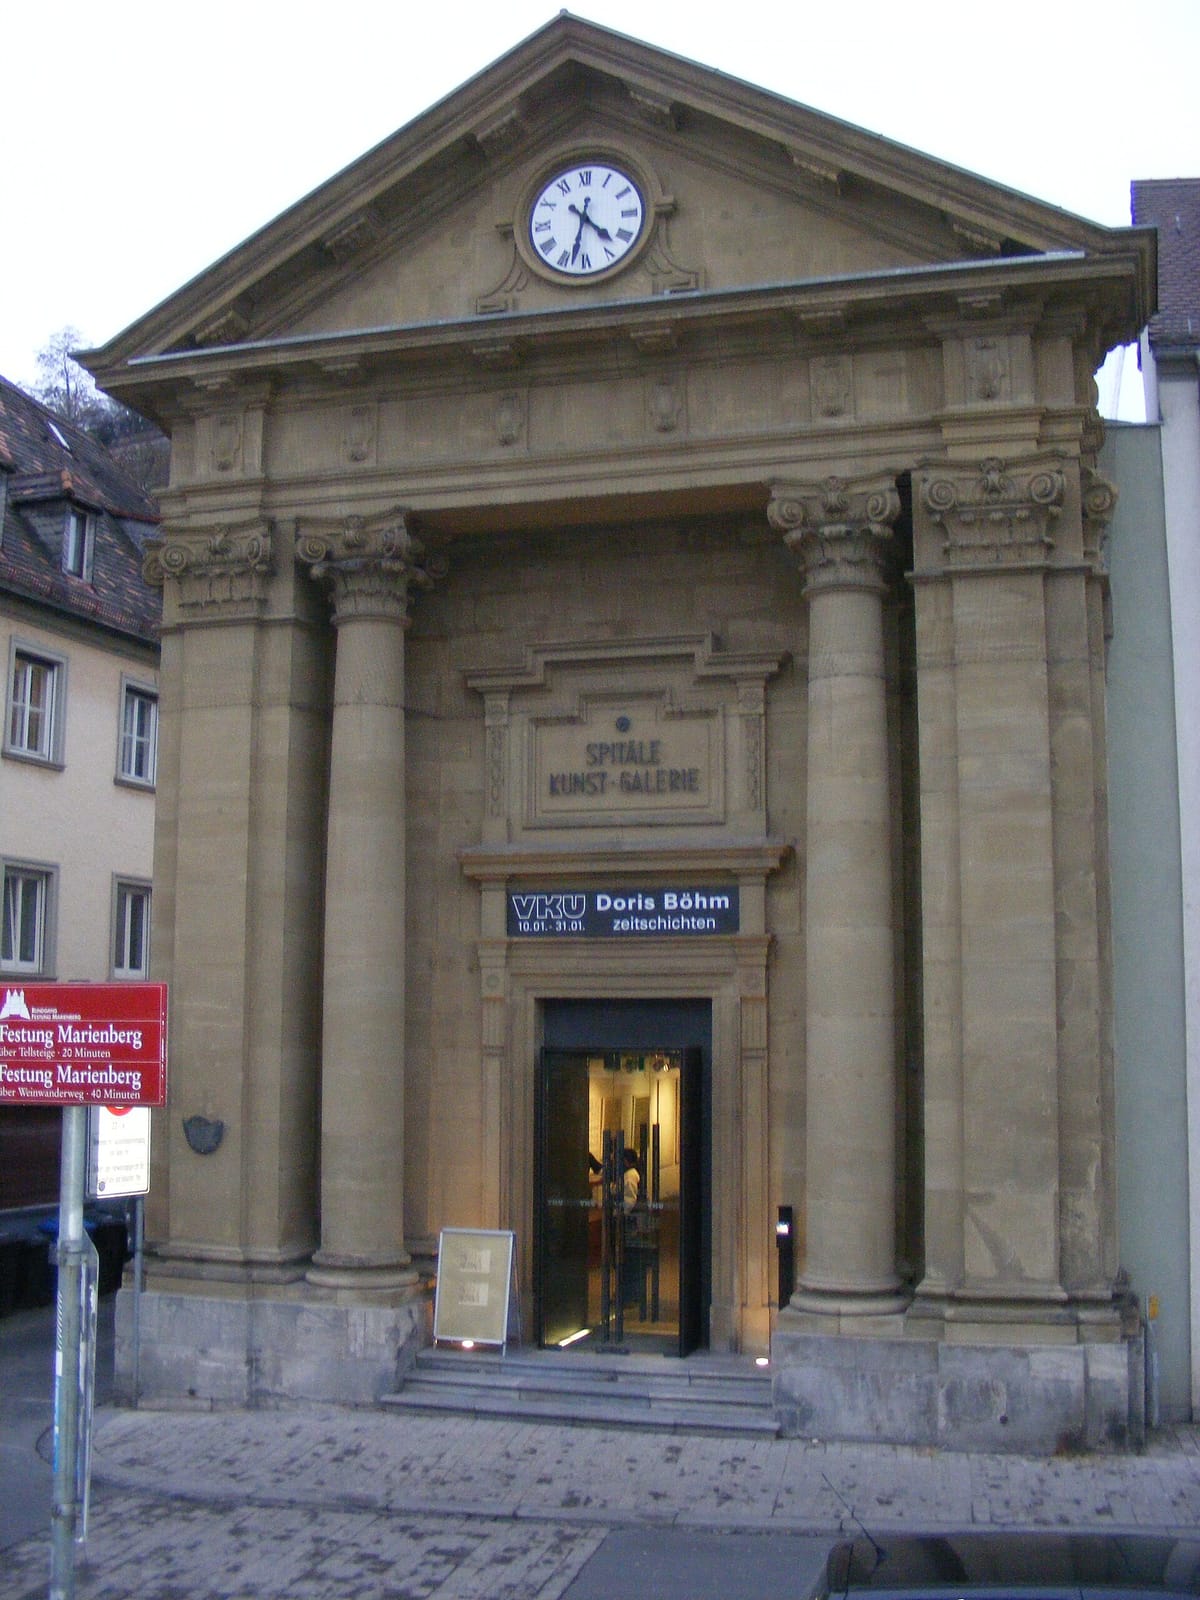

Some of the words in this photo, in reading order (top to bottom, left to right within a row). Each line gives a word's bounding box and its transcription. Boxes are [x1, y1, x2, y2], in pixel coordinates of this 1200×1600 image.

[585, 740, 661, 766] SPITÄLE
[512, 894, 586, 919] VKU
[596, 894, 656, 911] Doris
[664, 892, 730, 910] Böhm
[613, 915, 716, 931] zeitschichten
[0, 1024, 54, 1049] Festung
[58, 1023, 142, 1049] Marienberg
[19, 1046, 55, 1060] Tellsteige
[62, 1048, 72, 1058] 20
[75, 1048, 111, 1058] Minuten
[0, 1064, 53, 1088] Festung
[57, 1063, 142, 1090] Marienberg
[18, 1088, 84, 1101] Weinwanderweg
[90, 1089, 102, 1099] 40
[103, 1088, 141, 1100] Minuten
